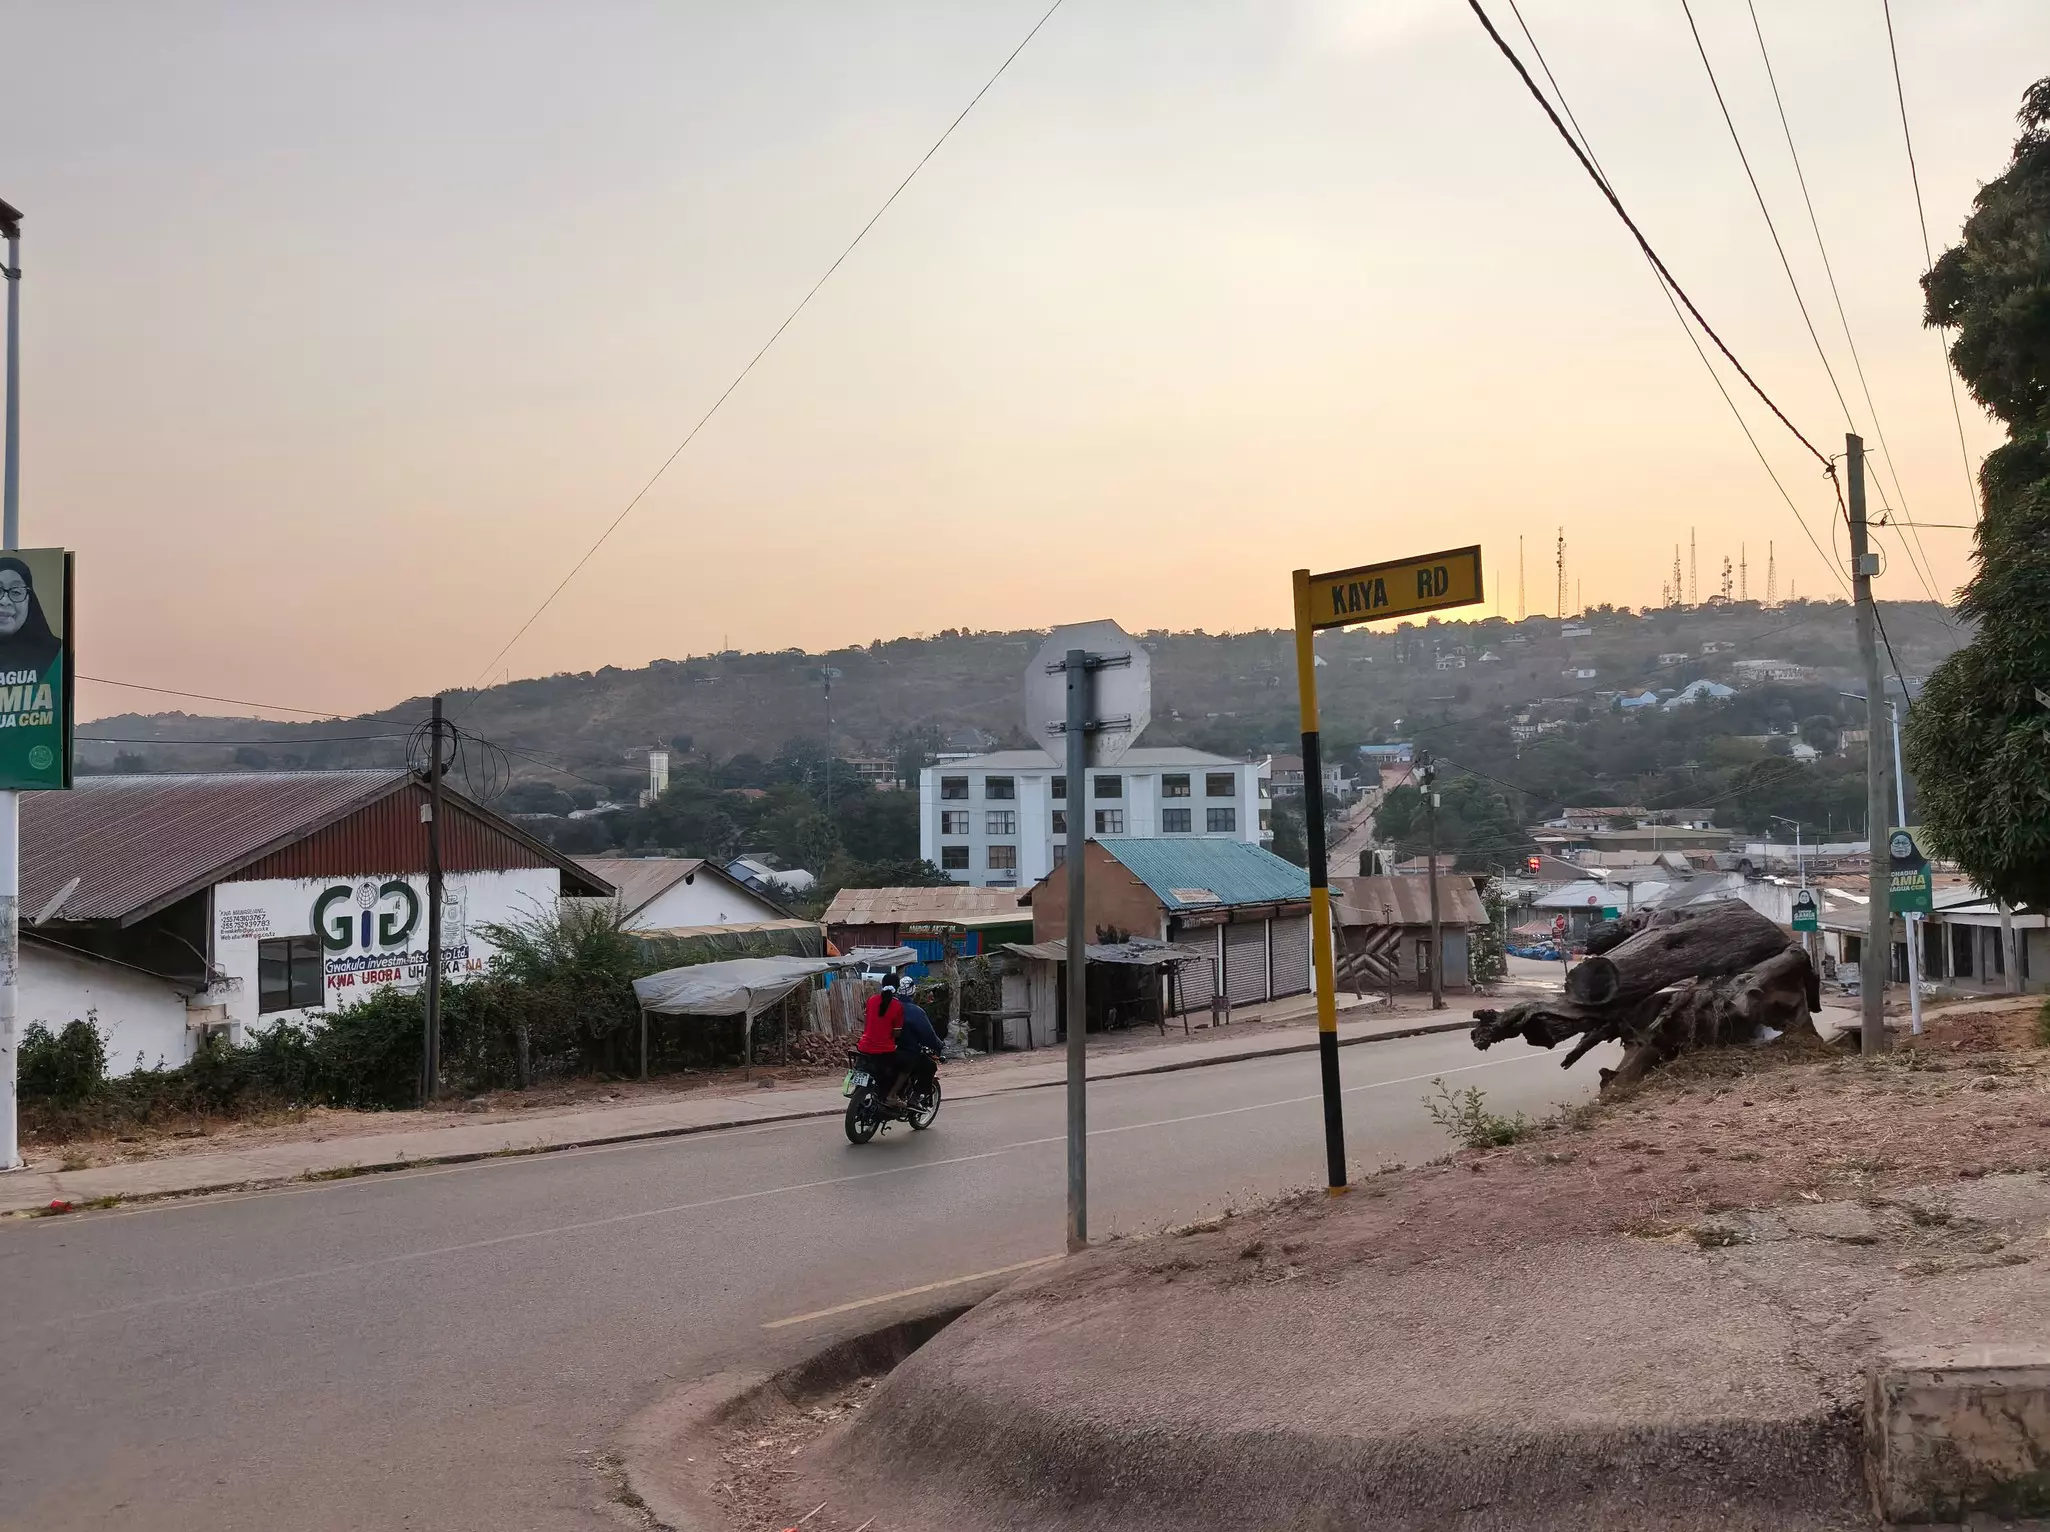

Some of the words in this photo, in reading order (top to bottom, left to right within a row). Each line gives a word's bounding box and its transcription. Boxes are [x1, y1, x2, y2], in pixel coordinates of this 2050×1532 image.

[1331, 577, 1389, 616] KAYA
[1416, 565, 1449, 600] RD
[19, 711, 53, 726] CCM
[1891, 874, 1926, 887] AMIA
[325, 957, 366, 974] Gwakula
[327, 972, 356, 989] KWA
[361, 967, 402, 985] UBORA
[465, 957, 483, 972] NA
